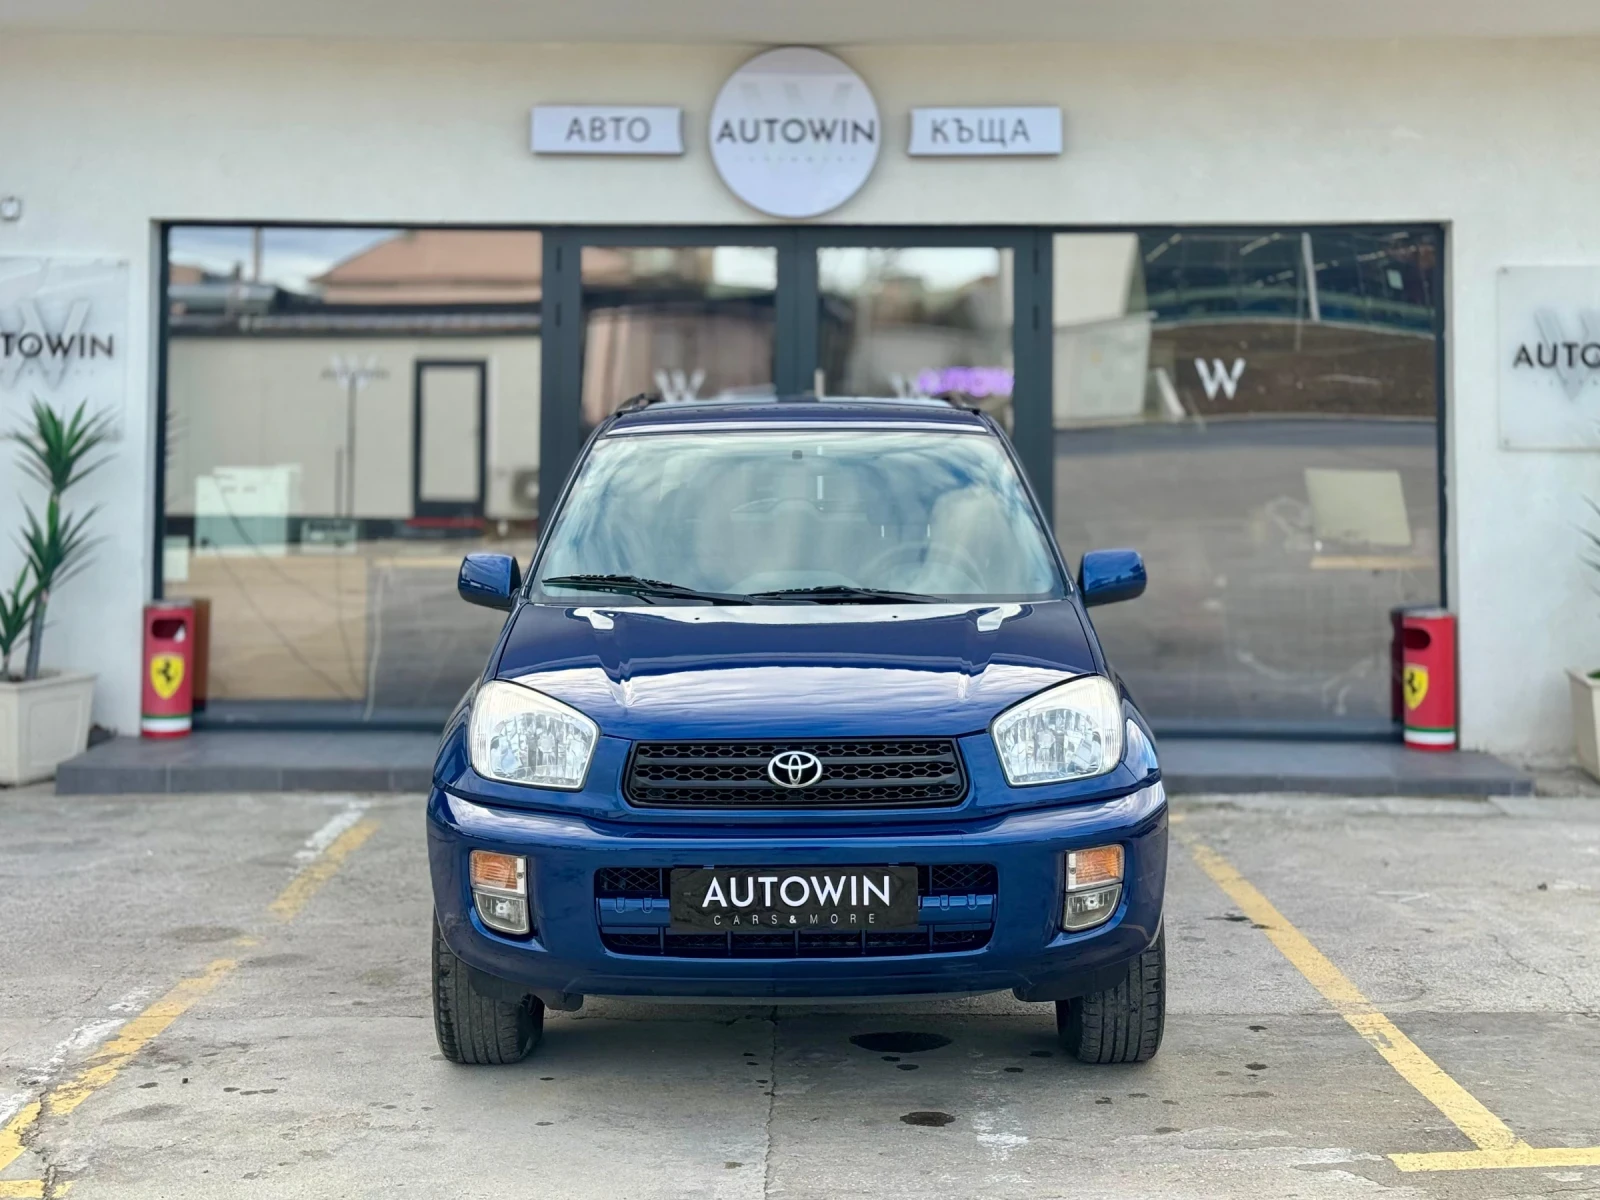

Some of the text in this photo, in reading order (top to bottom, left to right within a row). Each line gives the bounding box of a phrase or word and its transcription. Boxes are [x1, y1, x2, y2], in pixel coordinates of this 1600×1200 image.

[564, 116, 652, 143] АВТО
[715, 118, 876, 144] AUTOWIN
[930, 118, 1032, 148] КЪЩА
[1194, 357, 1246, 401] W
[702, 875, 890, 908] AUTOWIN
